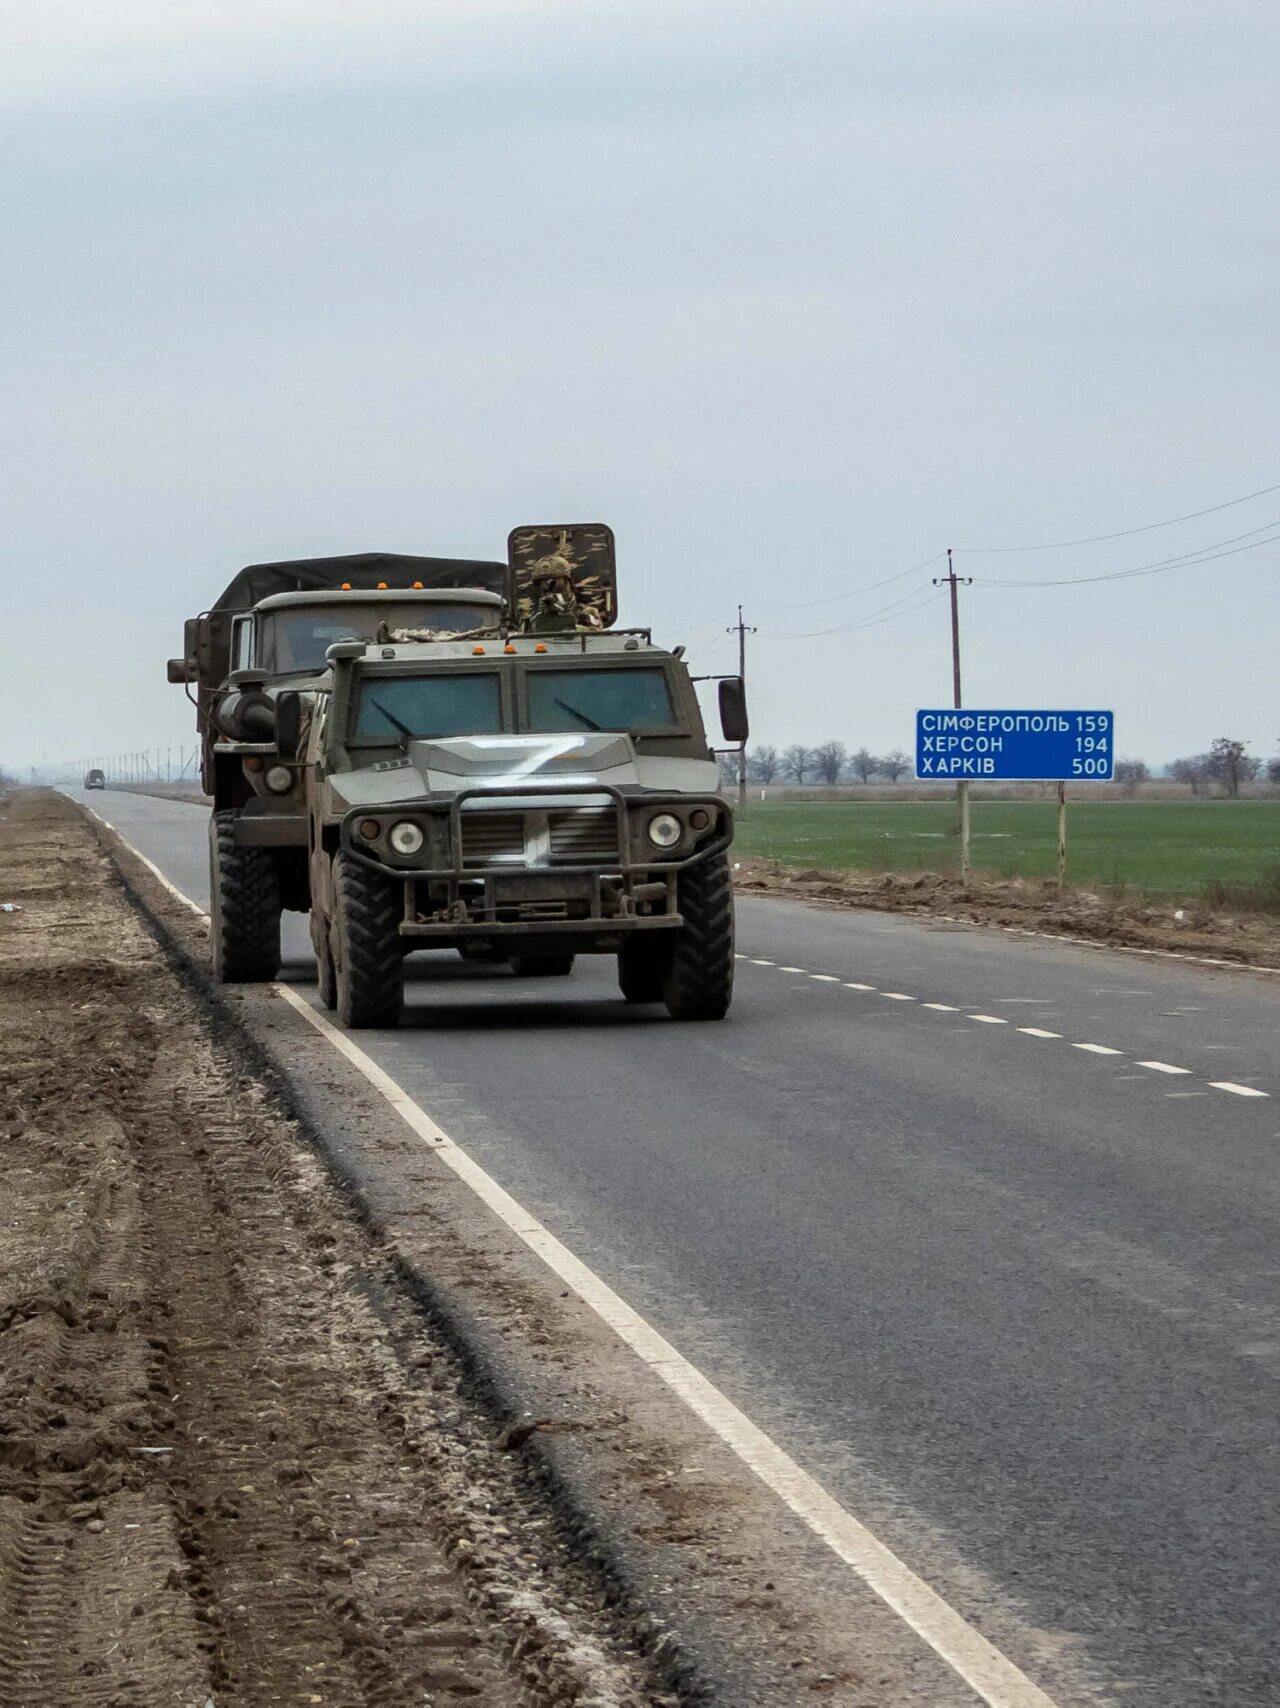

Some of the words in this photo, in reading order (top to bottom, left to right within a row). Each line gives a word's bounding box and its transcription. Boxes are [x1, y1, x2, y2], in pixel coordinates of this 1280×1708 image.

[922, 715, 1070, 732] СІМФЕРОПОЛЬ
[1076, 715, 1109, 732] 159
[922, 736, 1003, 753] ХЕРСОН
[1075, 736, 1108, 753] 194
[922, 757, 995, 774] ХАРКІВ
[1072, 758, 1108, 775] 500
